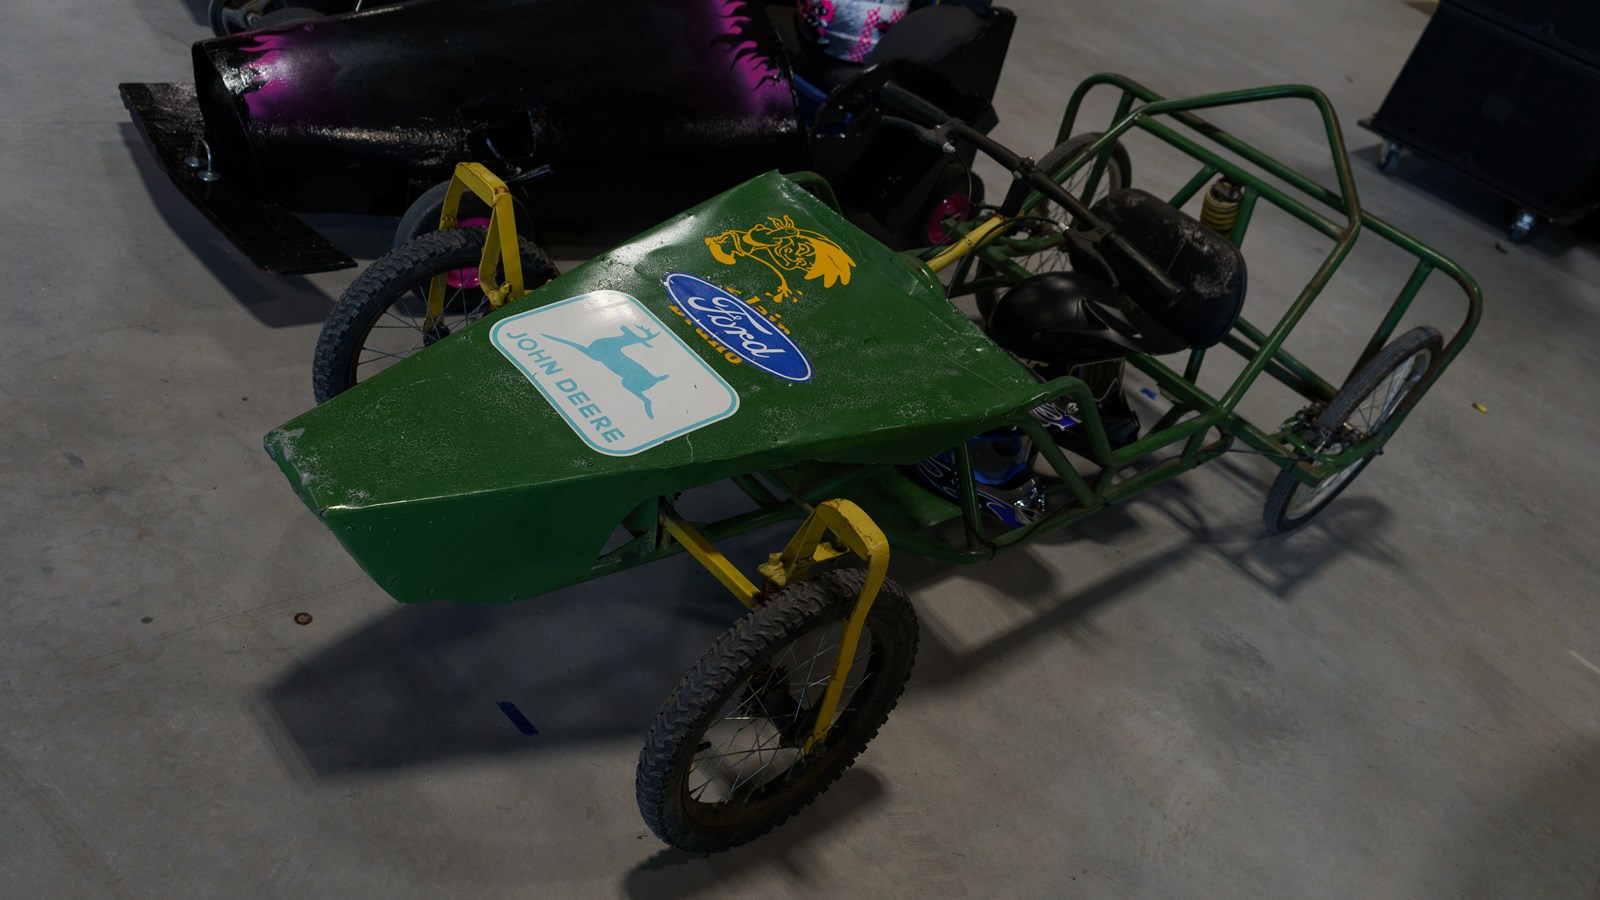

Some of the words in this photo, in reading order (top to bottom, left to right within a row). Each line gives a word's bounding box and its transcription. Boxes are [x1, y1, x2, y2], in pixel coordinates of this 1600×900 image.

[687, 296, 786, 359] Ford
[506, 331, 564, 376] JOHN
[555, 377, 626, 444] DEERE
